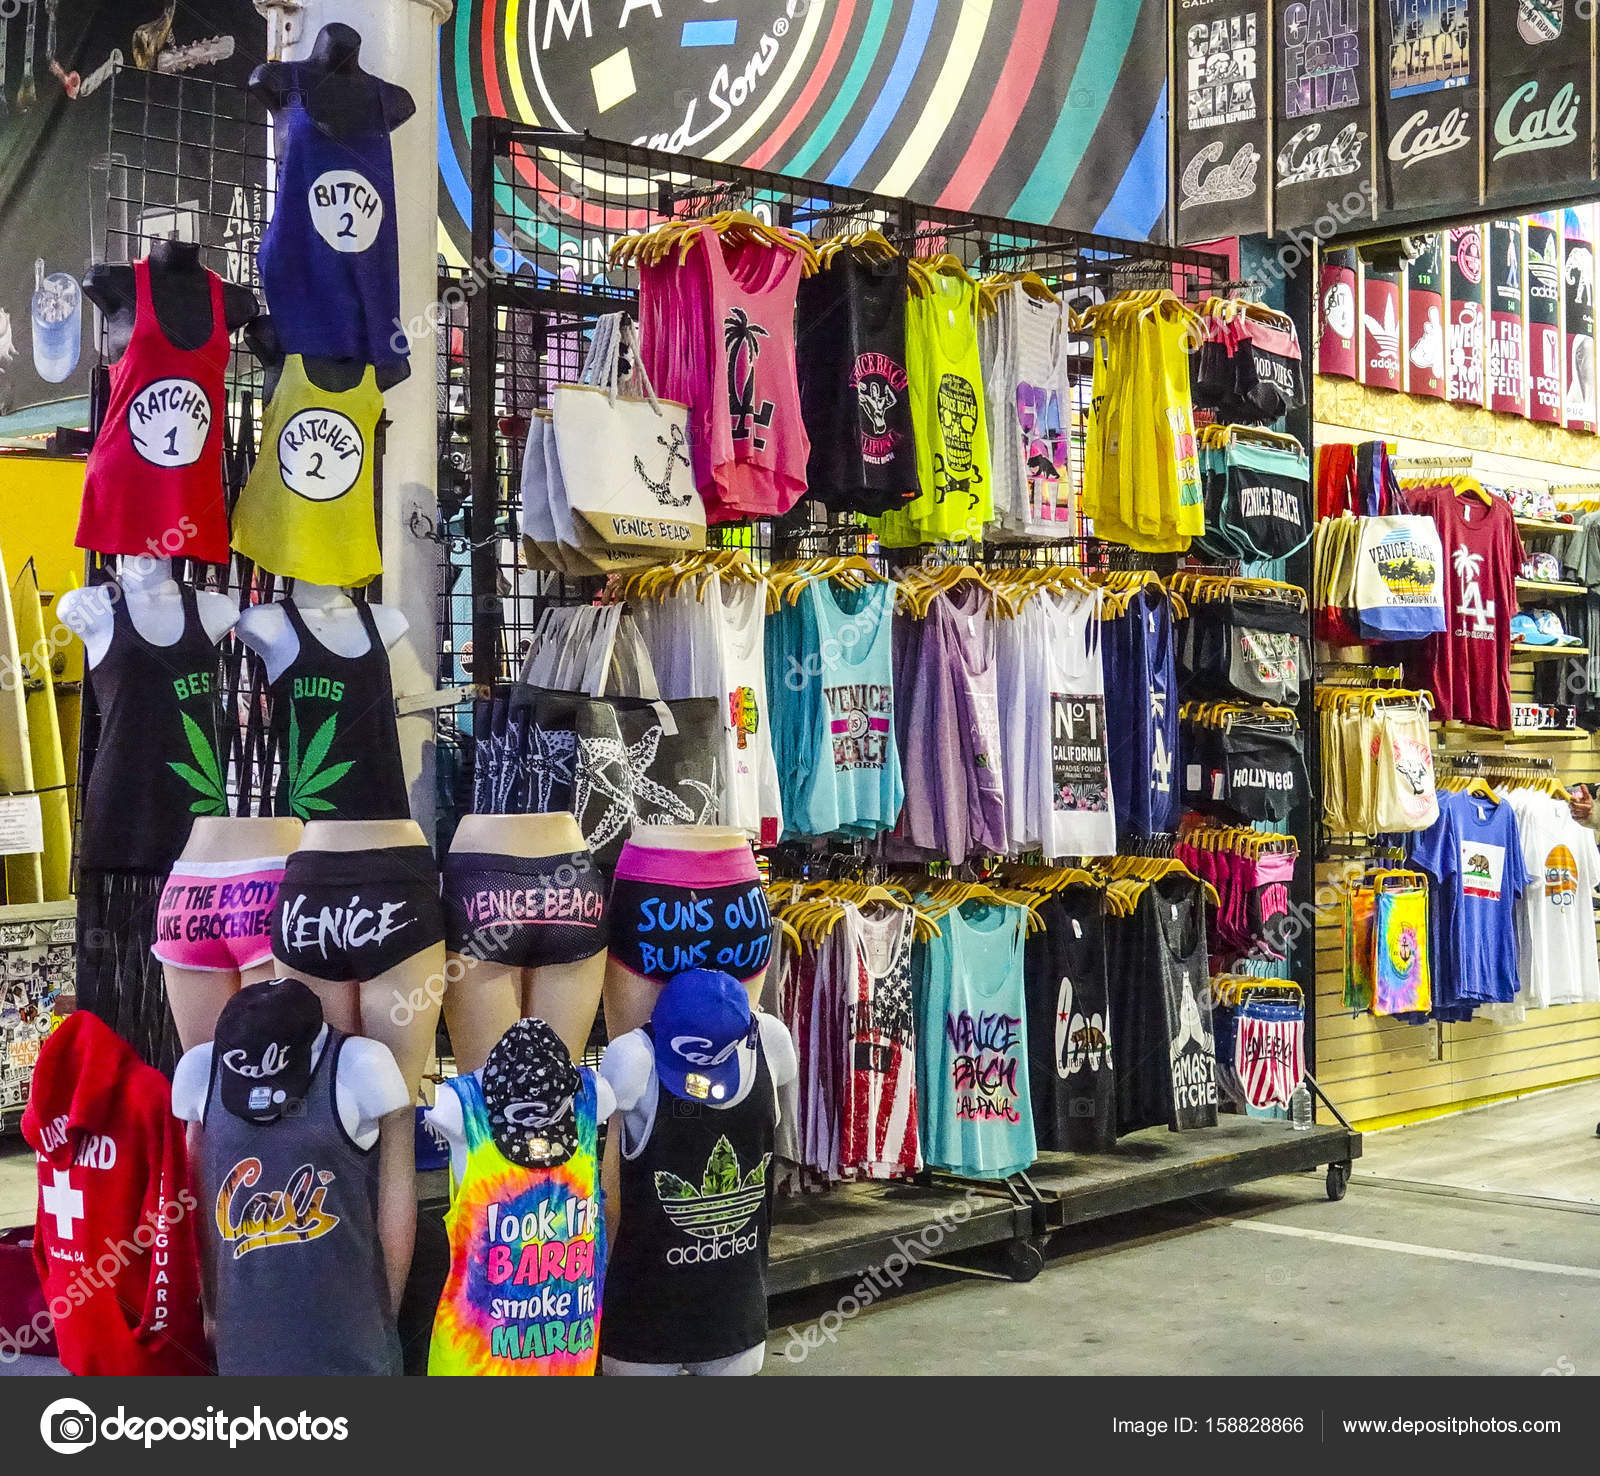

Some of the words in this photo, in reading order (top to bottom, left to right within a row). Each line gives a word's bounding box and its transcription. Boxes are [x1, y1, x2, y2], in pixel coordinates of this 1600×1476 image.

[1187, 12, 1257, 58] CALI
[1284, 0, 1359, 48] CALI
[1187, 80, 1257, 120] NIA
[1285, 68, 1361, 116] NIA
[1188, 114, 1226, 131] CALIFORNIA
[1226, 108, 1257, 124] REPUBLIC
[1493, 81, 1581, 162] Cali
[1387, 106, 1472, 170] Cali
[1276, 122, 1368, 191] Cali
[1180, 140, 1260, 211] Cali
[314, 182, 377, 219] BITCH
[337, 212, 356, 239] 2
[133, 386, 209, 430] RATCHET
[163, 426, 181, 457] 1
[286, 418, 361, 461] RATCHET
[305, 452, 326, 480] 2
[1241, 486, 1271, 518] VENICE
[1271, 486, 1301, 526] BEACH
[612, 518, 655, 539] VENICE
[659, 524, 692, 542] BEACH
[1368, 541, 1408, 563] VENICE
[292, 676, 345, 702] BUDS
[823, 684, 892, 715] VENICE
[1053, 745, 1102, 762] CALIFORNIA
[1055, 764, 1080, 772] PARADISE
[185, 884, 217, 910] THE
[219, 880, 279, 910] BOOTY
[463, 888, 538, 923] VENICE
[543, 888, 604, 922] BEACH
[638, 896, 714, 932] SUNS
[637, 940, 708, 975] BUNS
[223, 1042, 291, 1080] Cali
[1174, 1053, 1216, 1087] AMAST
[1173, 1081, 1218, 1110] ITCHE
[215, 1156, 341, 1260] Cali
[487, 1197, 556, 1243] look
[666, 1227, 759, 1266] addicted
[490, 1289, 571, 1321] smoke
